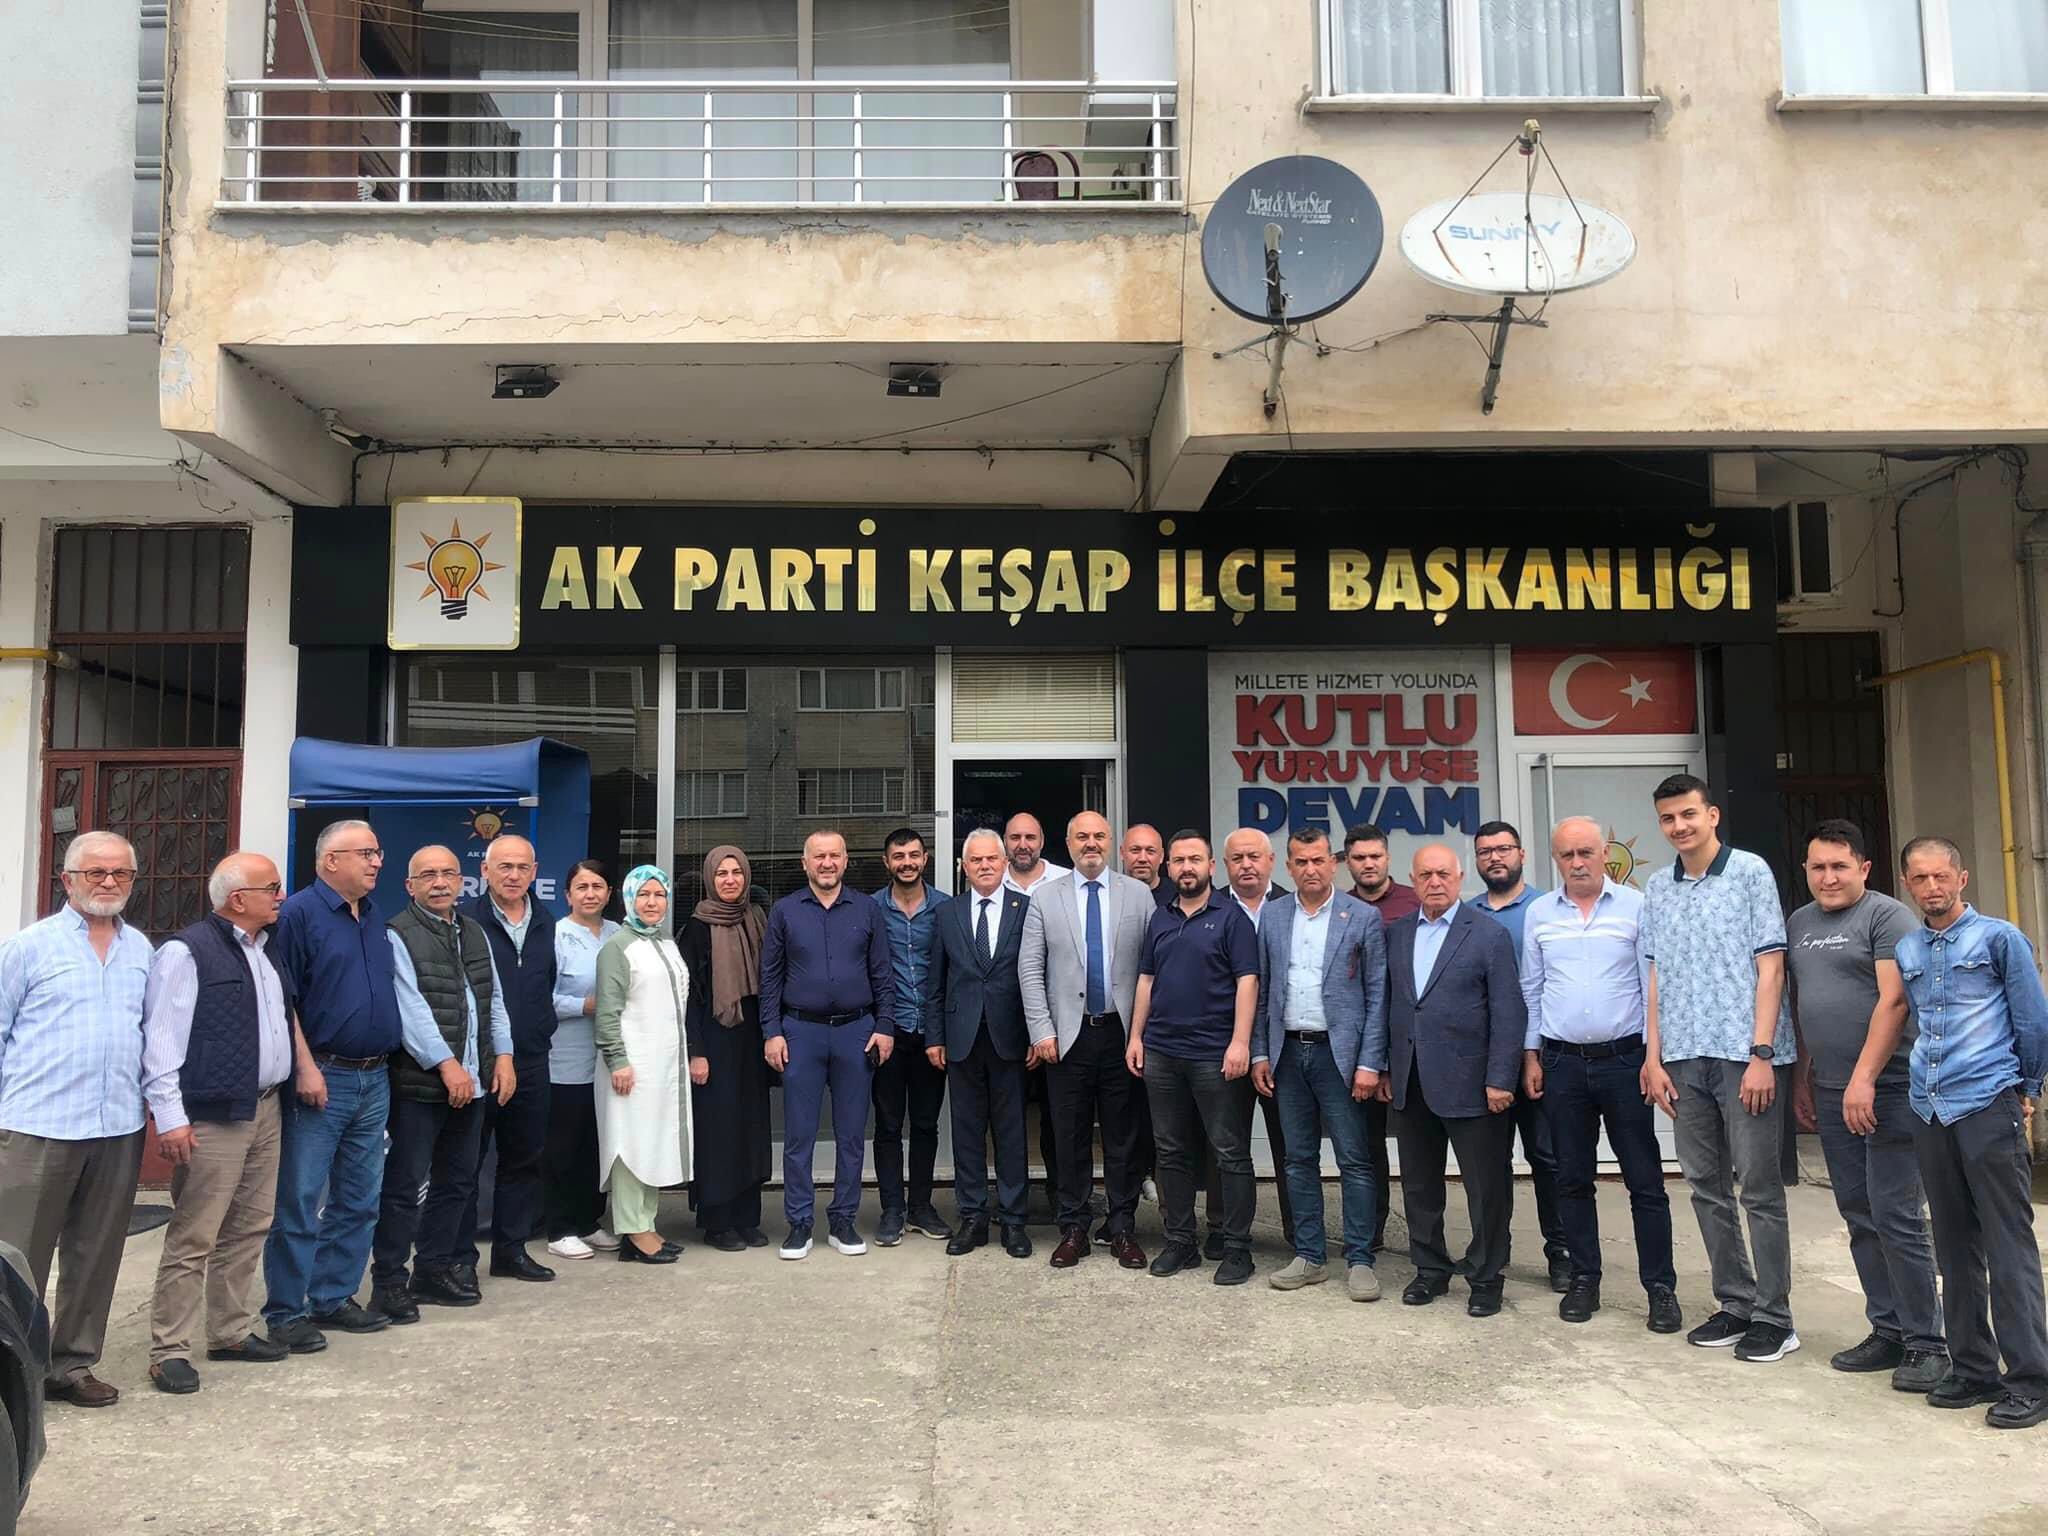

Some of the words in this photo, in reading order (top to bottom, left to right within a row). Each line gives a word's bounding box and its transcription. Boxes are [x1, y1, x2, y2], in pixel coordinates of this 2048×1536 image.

[540, 546, 644, 611] AK
[673, 518, 877, 612] PARTİ
[909, 548, 1131, 627] KEŞAP
[1157, 518, 1297, 627] İLÇE
[1328, 522, 1751, 627] BAŞKANLIĞI
[1391, 673, 1479, 689] YOLUNDA
[1235, 694, 1478, 747] KUTLU
[1238, 786, 1481, 836] DEVAM
